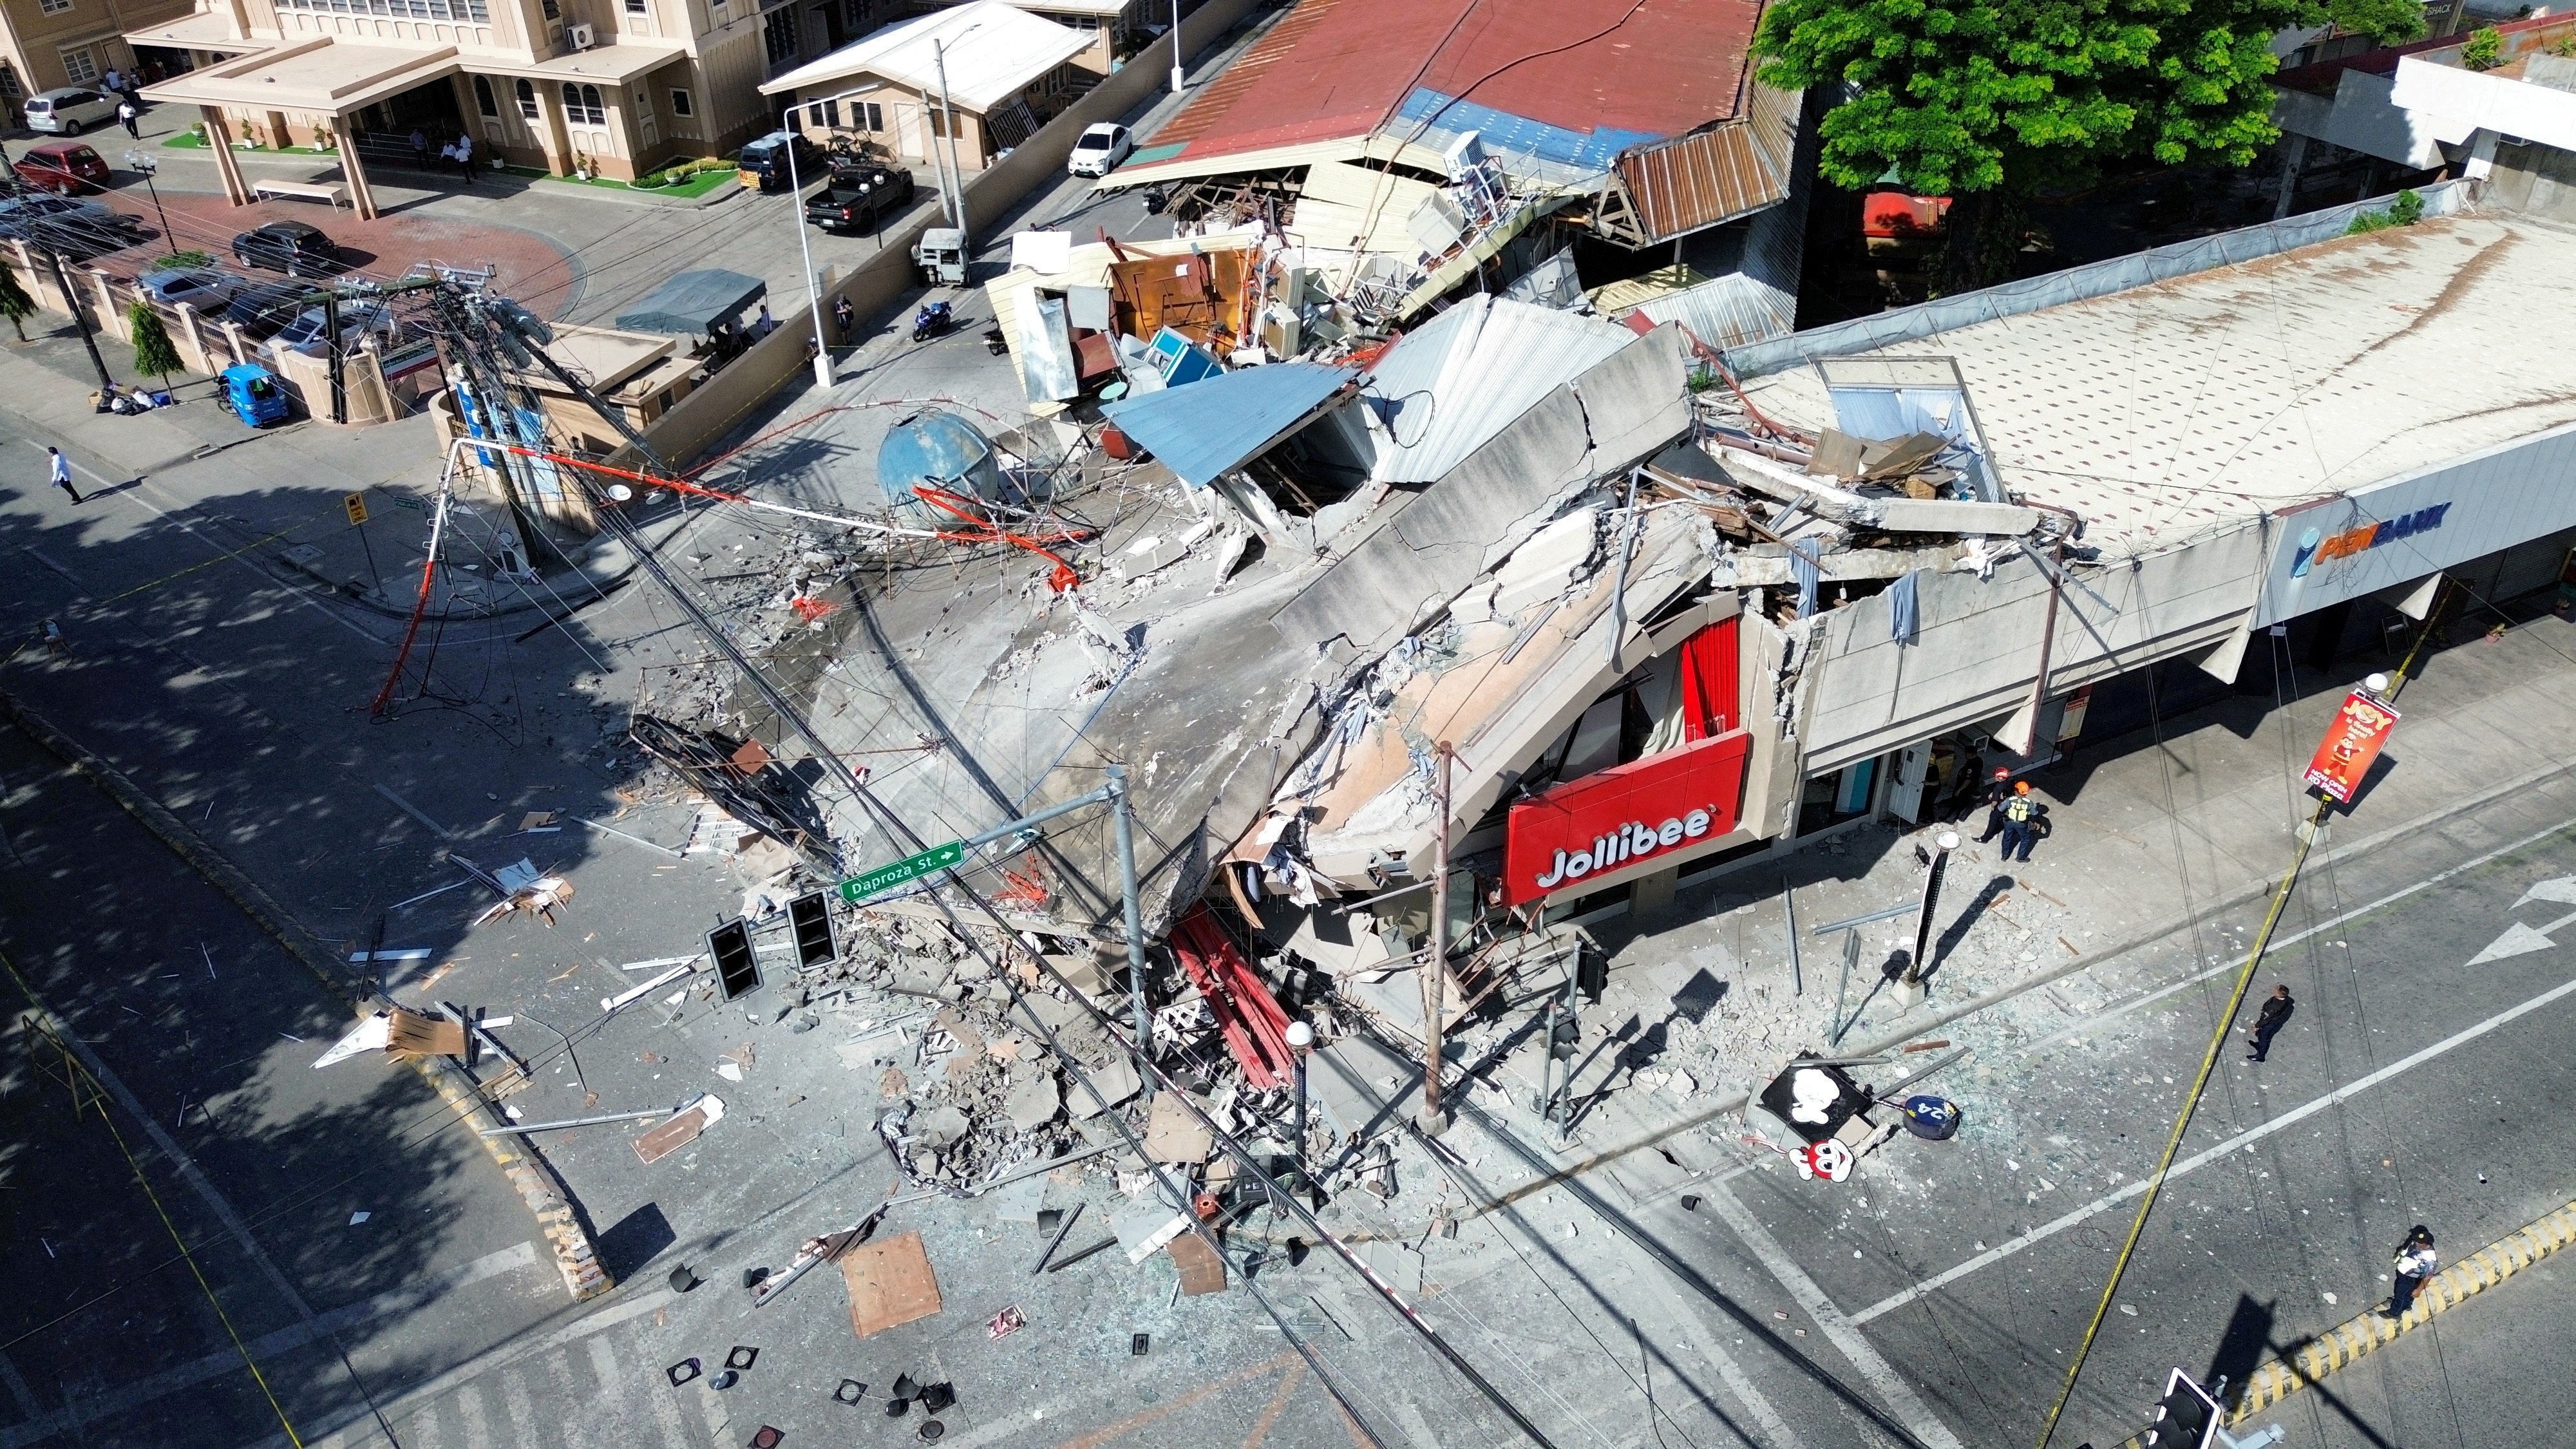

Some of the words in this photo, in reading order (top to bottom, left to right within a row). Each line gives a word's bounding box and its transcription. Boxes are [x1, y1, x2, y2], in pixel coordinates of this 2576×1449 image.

[2311, 768, 2329, 782] NOW
[2329, 779, 2348, 793] OPEN
[2321, 782, 2344, 800] Plaza
[1536, 809, 1710, 887] Jollibee
[851, 866, 911, 895] Daproza
[918, 857, 936, 869] St.
[1918, 1103, 1944, 1120] 24
